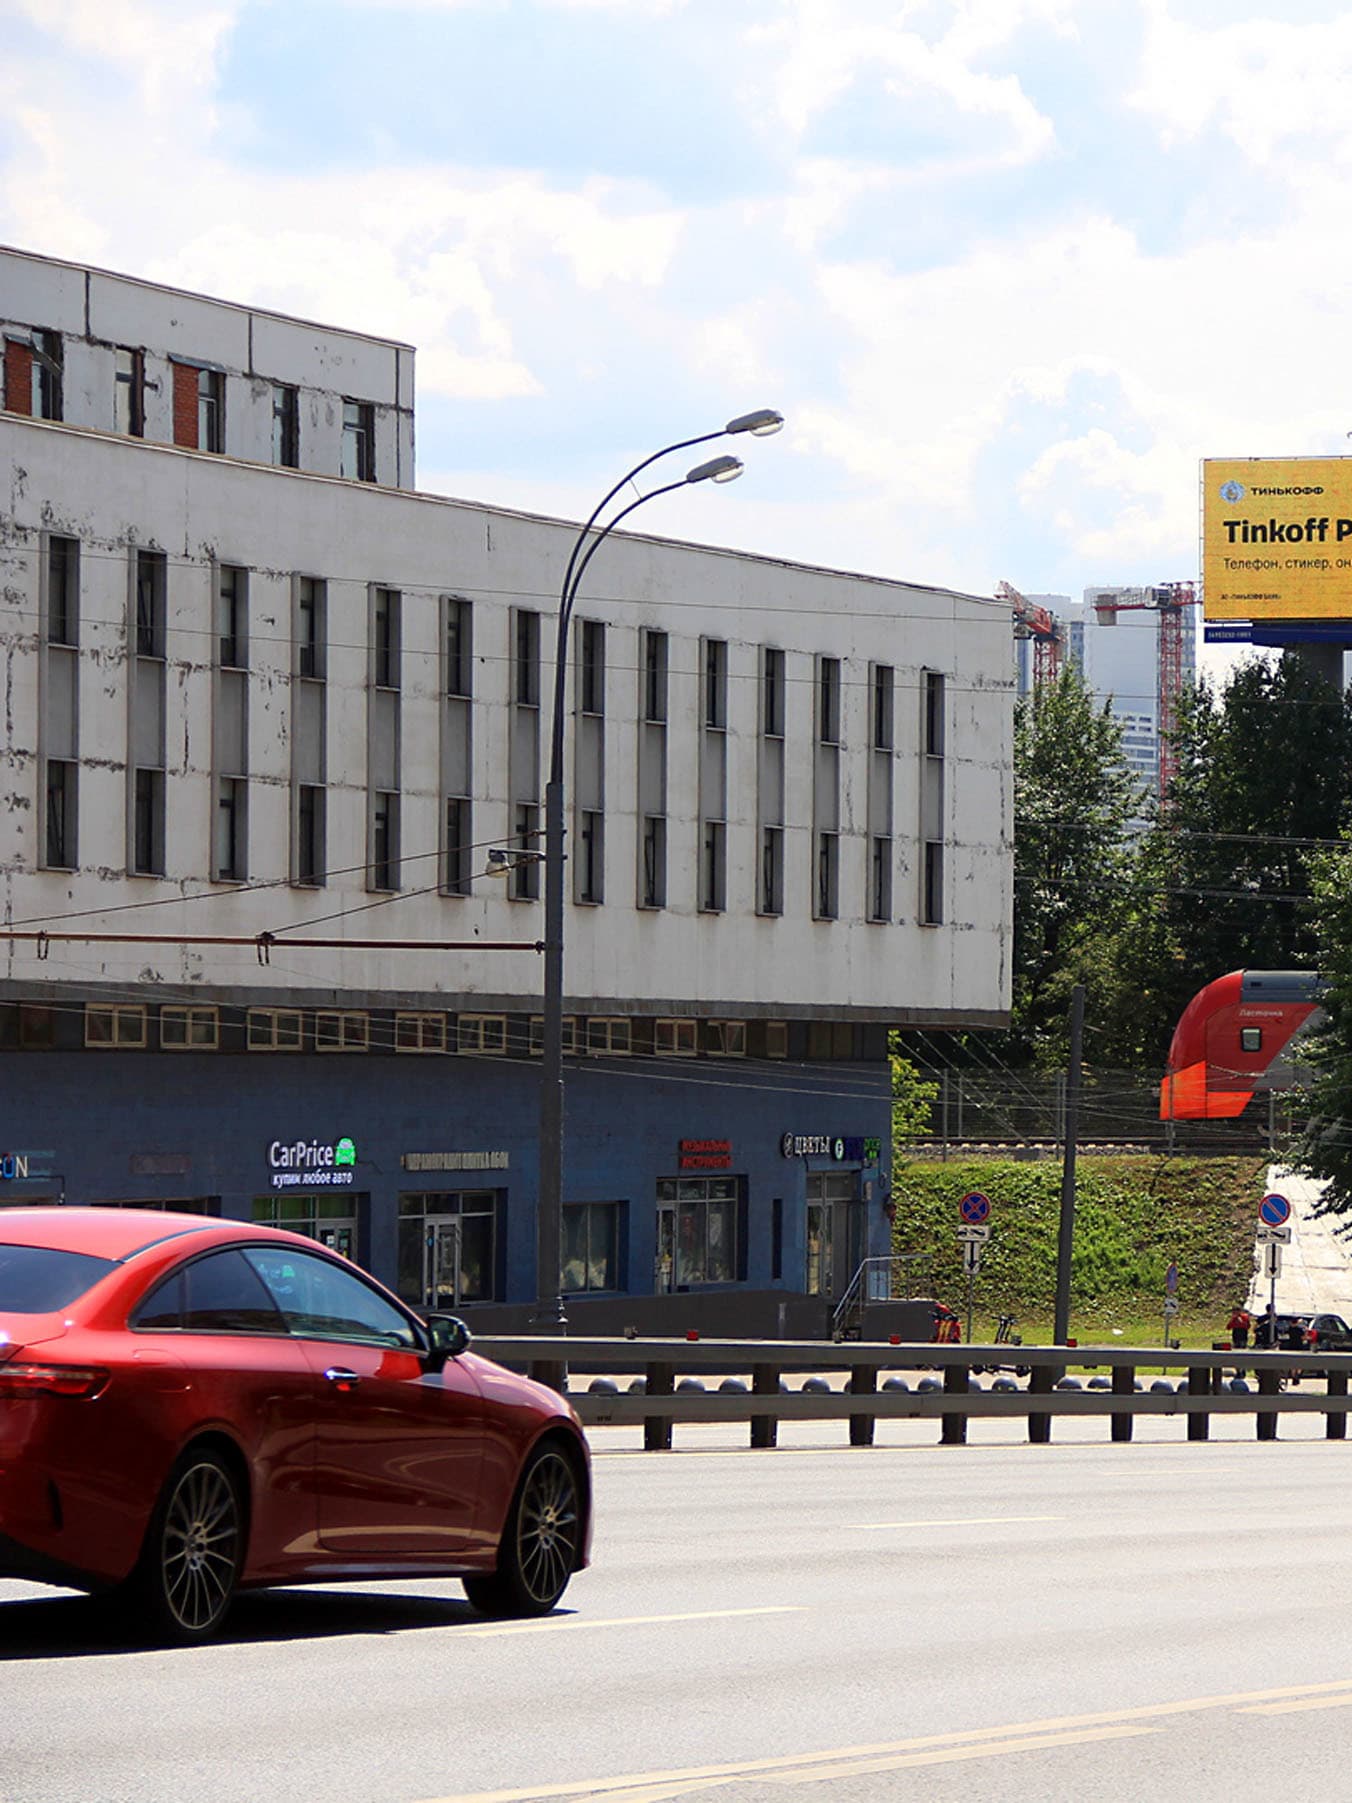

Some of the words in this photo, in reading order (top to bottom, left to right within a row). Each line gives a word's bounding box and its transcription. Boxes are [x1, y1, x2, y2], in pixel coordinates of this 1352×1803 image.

[1250, 486, 1324, 496] ТИНЬКОФФ
[1223, 517, 1329, 543] Tinkoff
[1223, 557, 1283, 571] Телефон,
[1285, 557, 1332, 571] стикер,
[270, 1140, 334, 1168] CarPrice
[794, 1136, 831, 1157] ЦВЕТЫ
[272, 1173, 301, 1189] купим
[302, 1168, 331, 1185] любое
[332, 1172, 353, 1184] авто
